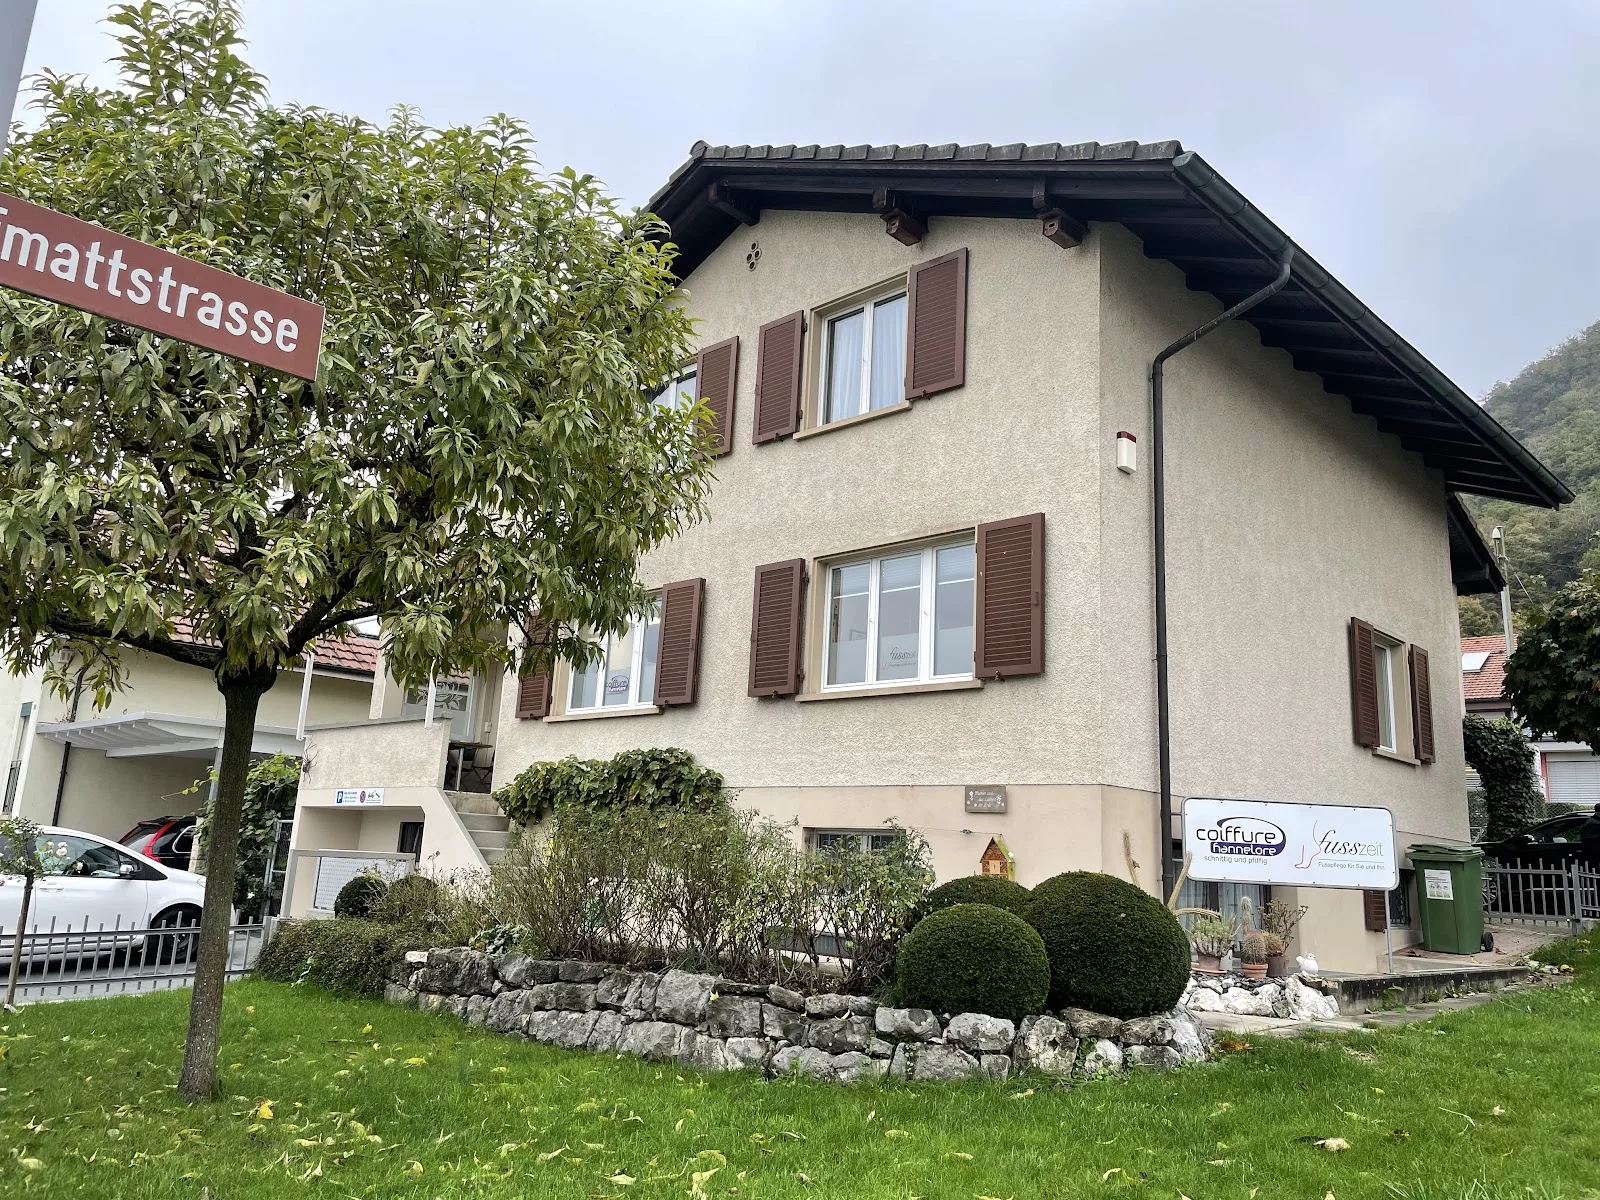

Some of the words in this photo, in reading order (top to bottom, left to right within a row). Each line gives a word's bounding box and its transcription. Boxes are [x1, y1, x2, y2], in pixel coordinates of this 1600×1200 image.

[0, 207, 299, 352] mattstrasse
[1196, 826, 1276, 844] coiffure
[1319, 829, 1384, 857] fusszeit
[1212, 842, 1277, 856] hannelore
[1204, 855, 1233, 864] schnittig
[1234, 856, 1247, 864] und
[1248, 857, 1268, 866] pfiffig
